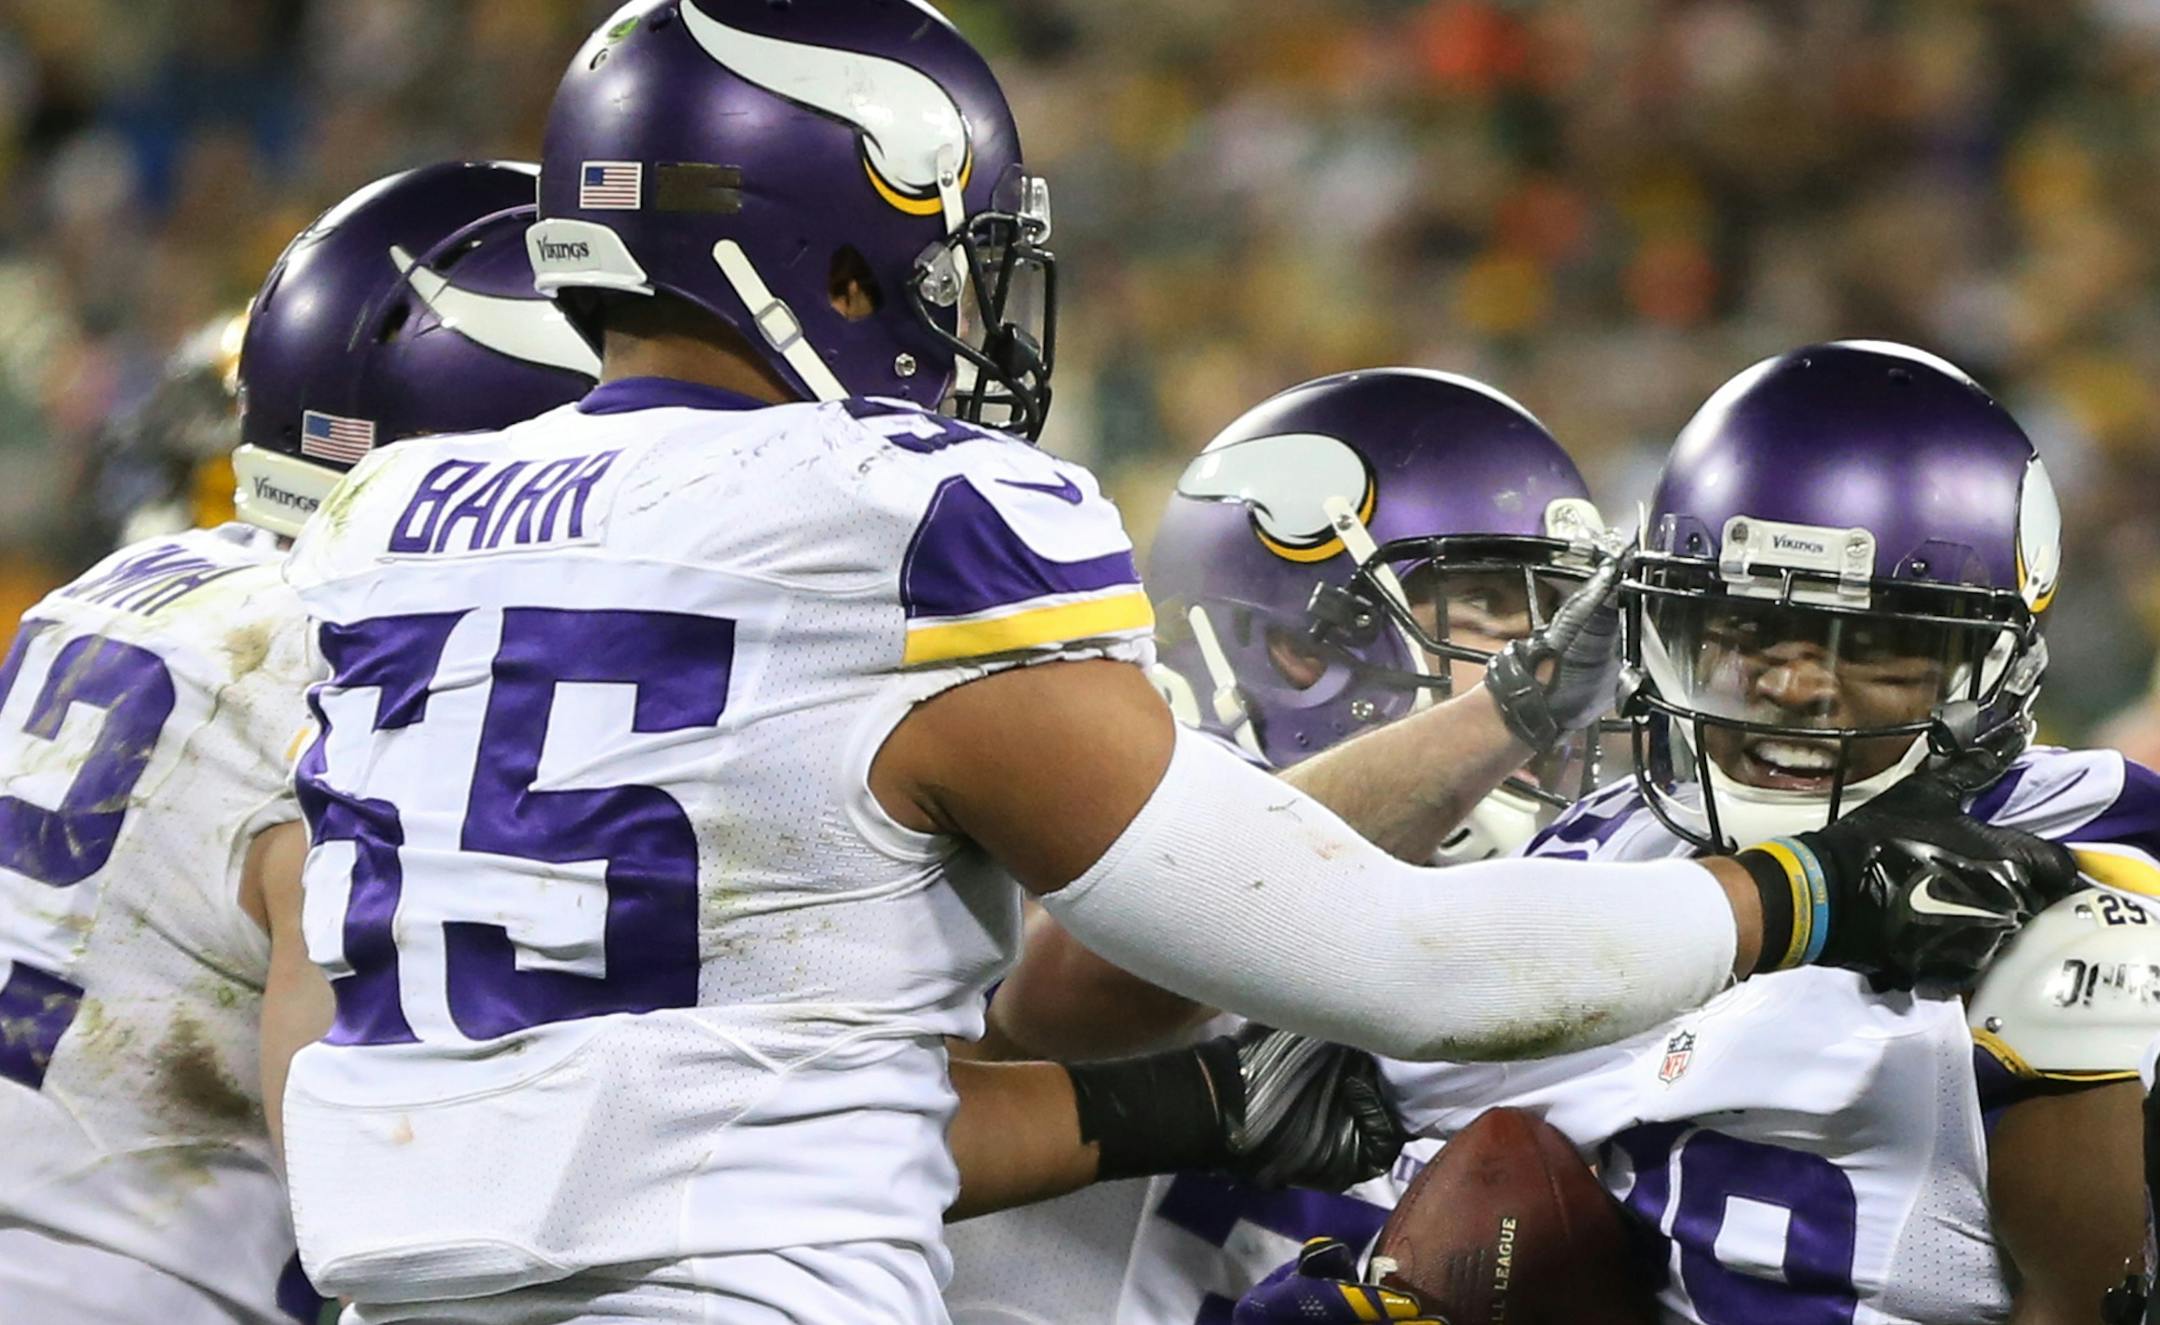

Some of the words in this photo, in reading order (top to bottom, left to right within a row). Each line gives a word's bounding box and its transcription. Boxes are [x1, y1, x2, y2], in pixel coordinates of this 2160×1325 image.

[387, 448, 626, 554] BARR
[295, 606, 737, 1045] 55
[1494, 1217, 1517, 1291] LEAGUE
